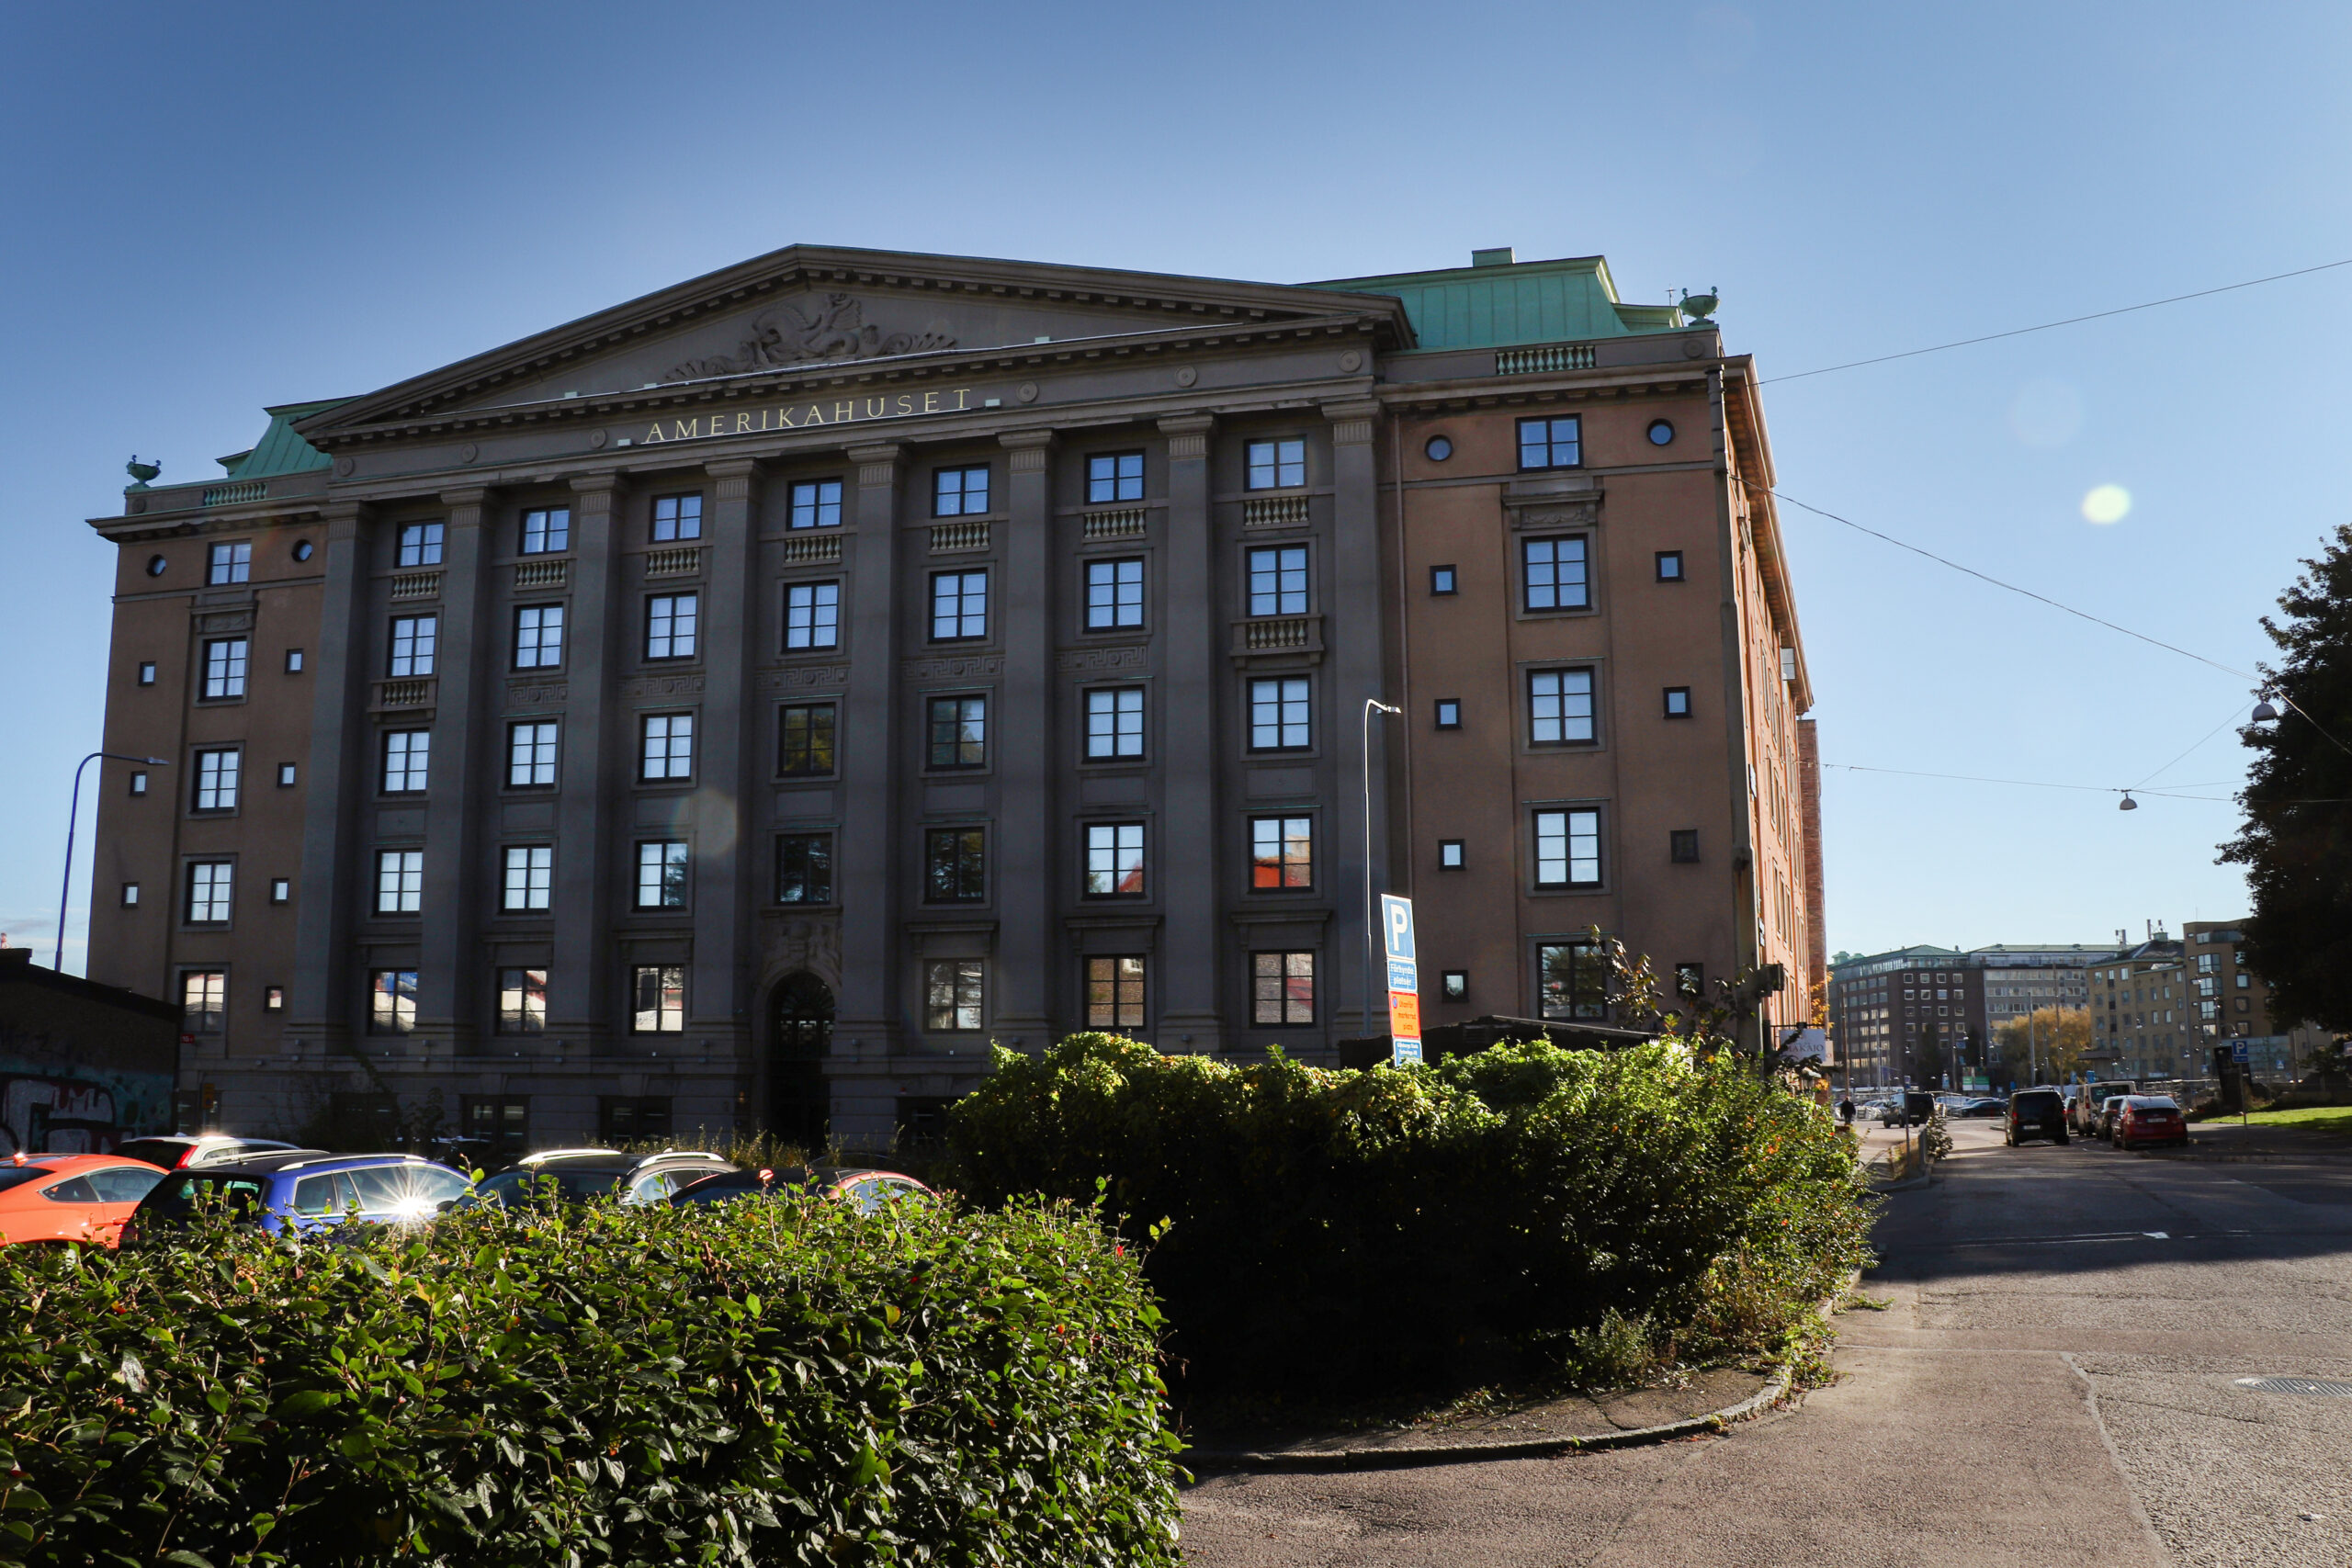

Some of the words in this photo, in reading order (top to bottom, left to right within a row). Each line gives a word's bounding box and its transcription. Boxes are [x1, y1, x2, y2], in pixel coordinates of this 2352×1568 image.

[645, 389, 971, 443] AMERIKAHUSET
[1390, 904, 1408, 952] P
[1394, 976, 1412, 986] platser
[2236, 1043, 2245, 1054] P
